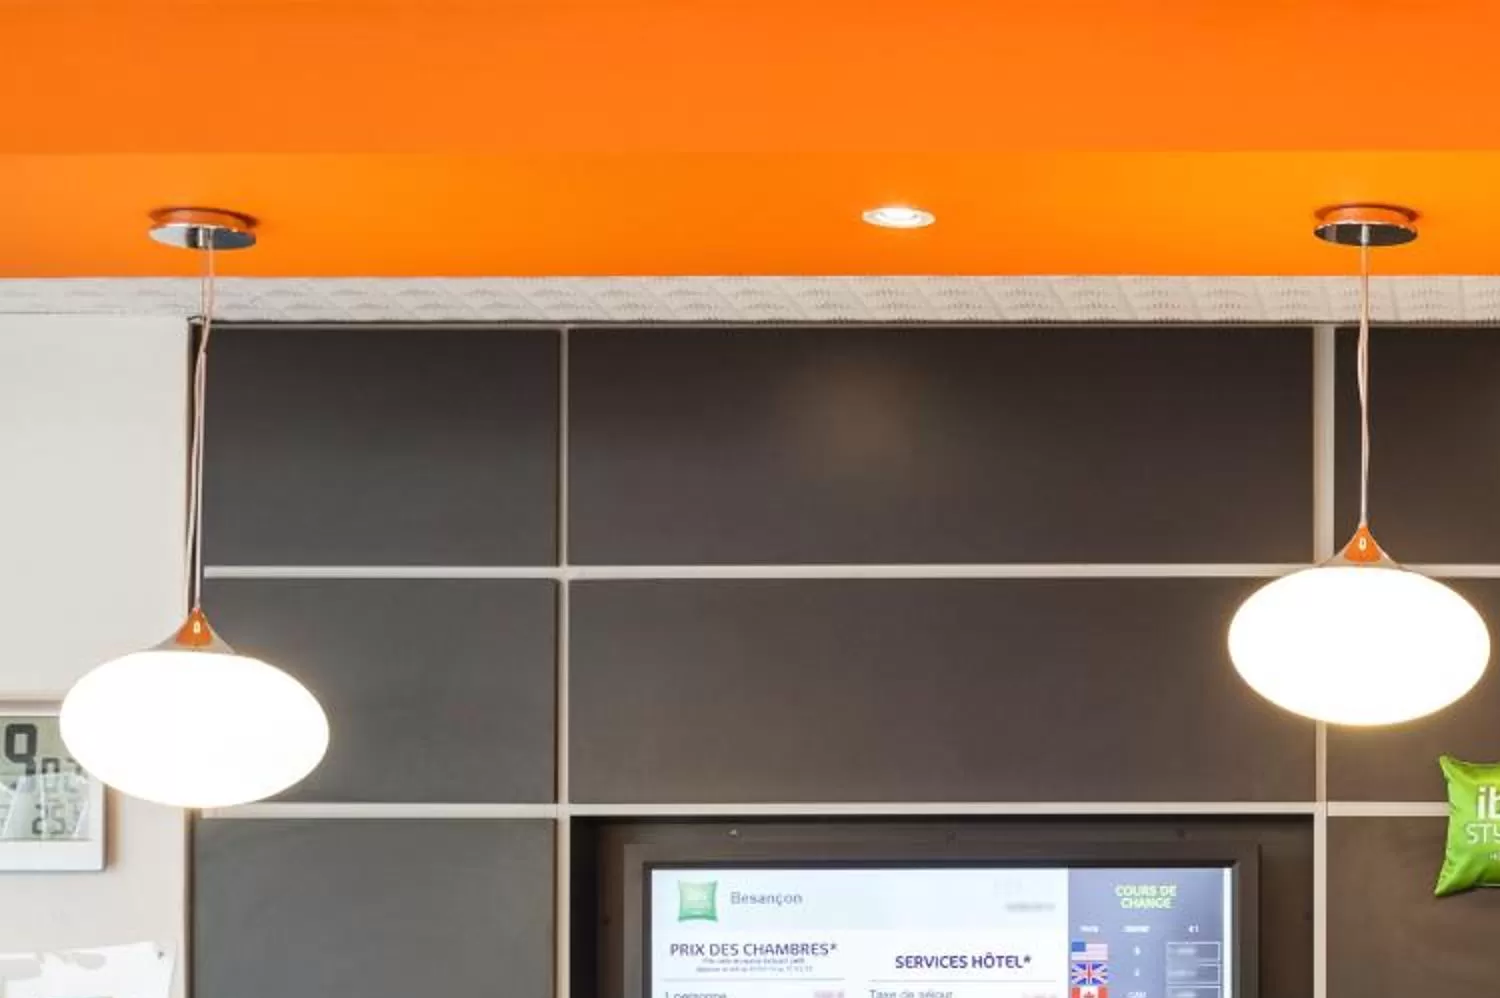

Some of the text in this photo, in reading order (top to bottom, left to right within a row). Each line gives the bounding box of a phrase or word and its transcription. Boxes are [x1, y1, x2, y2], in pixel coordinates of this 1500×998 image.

[729, 891, 803, 907] Besançon
[1120, 898, 1172, 909] CHANGE
[669, 943, 705, 957] PRIX
[709, 943, 739, 957] DES
[895, 955, 968, 969] SERVICES
